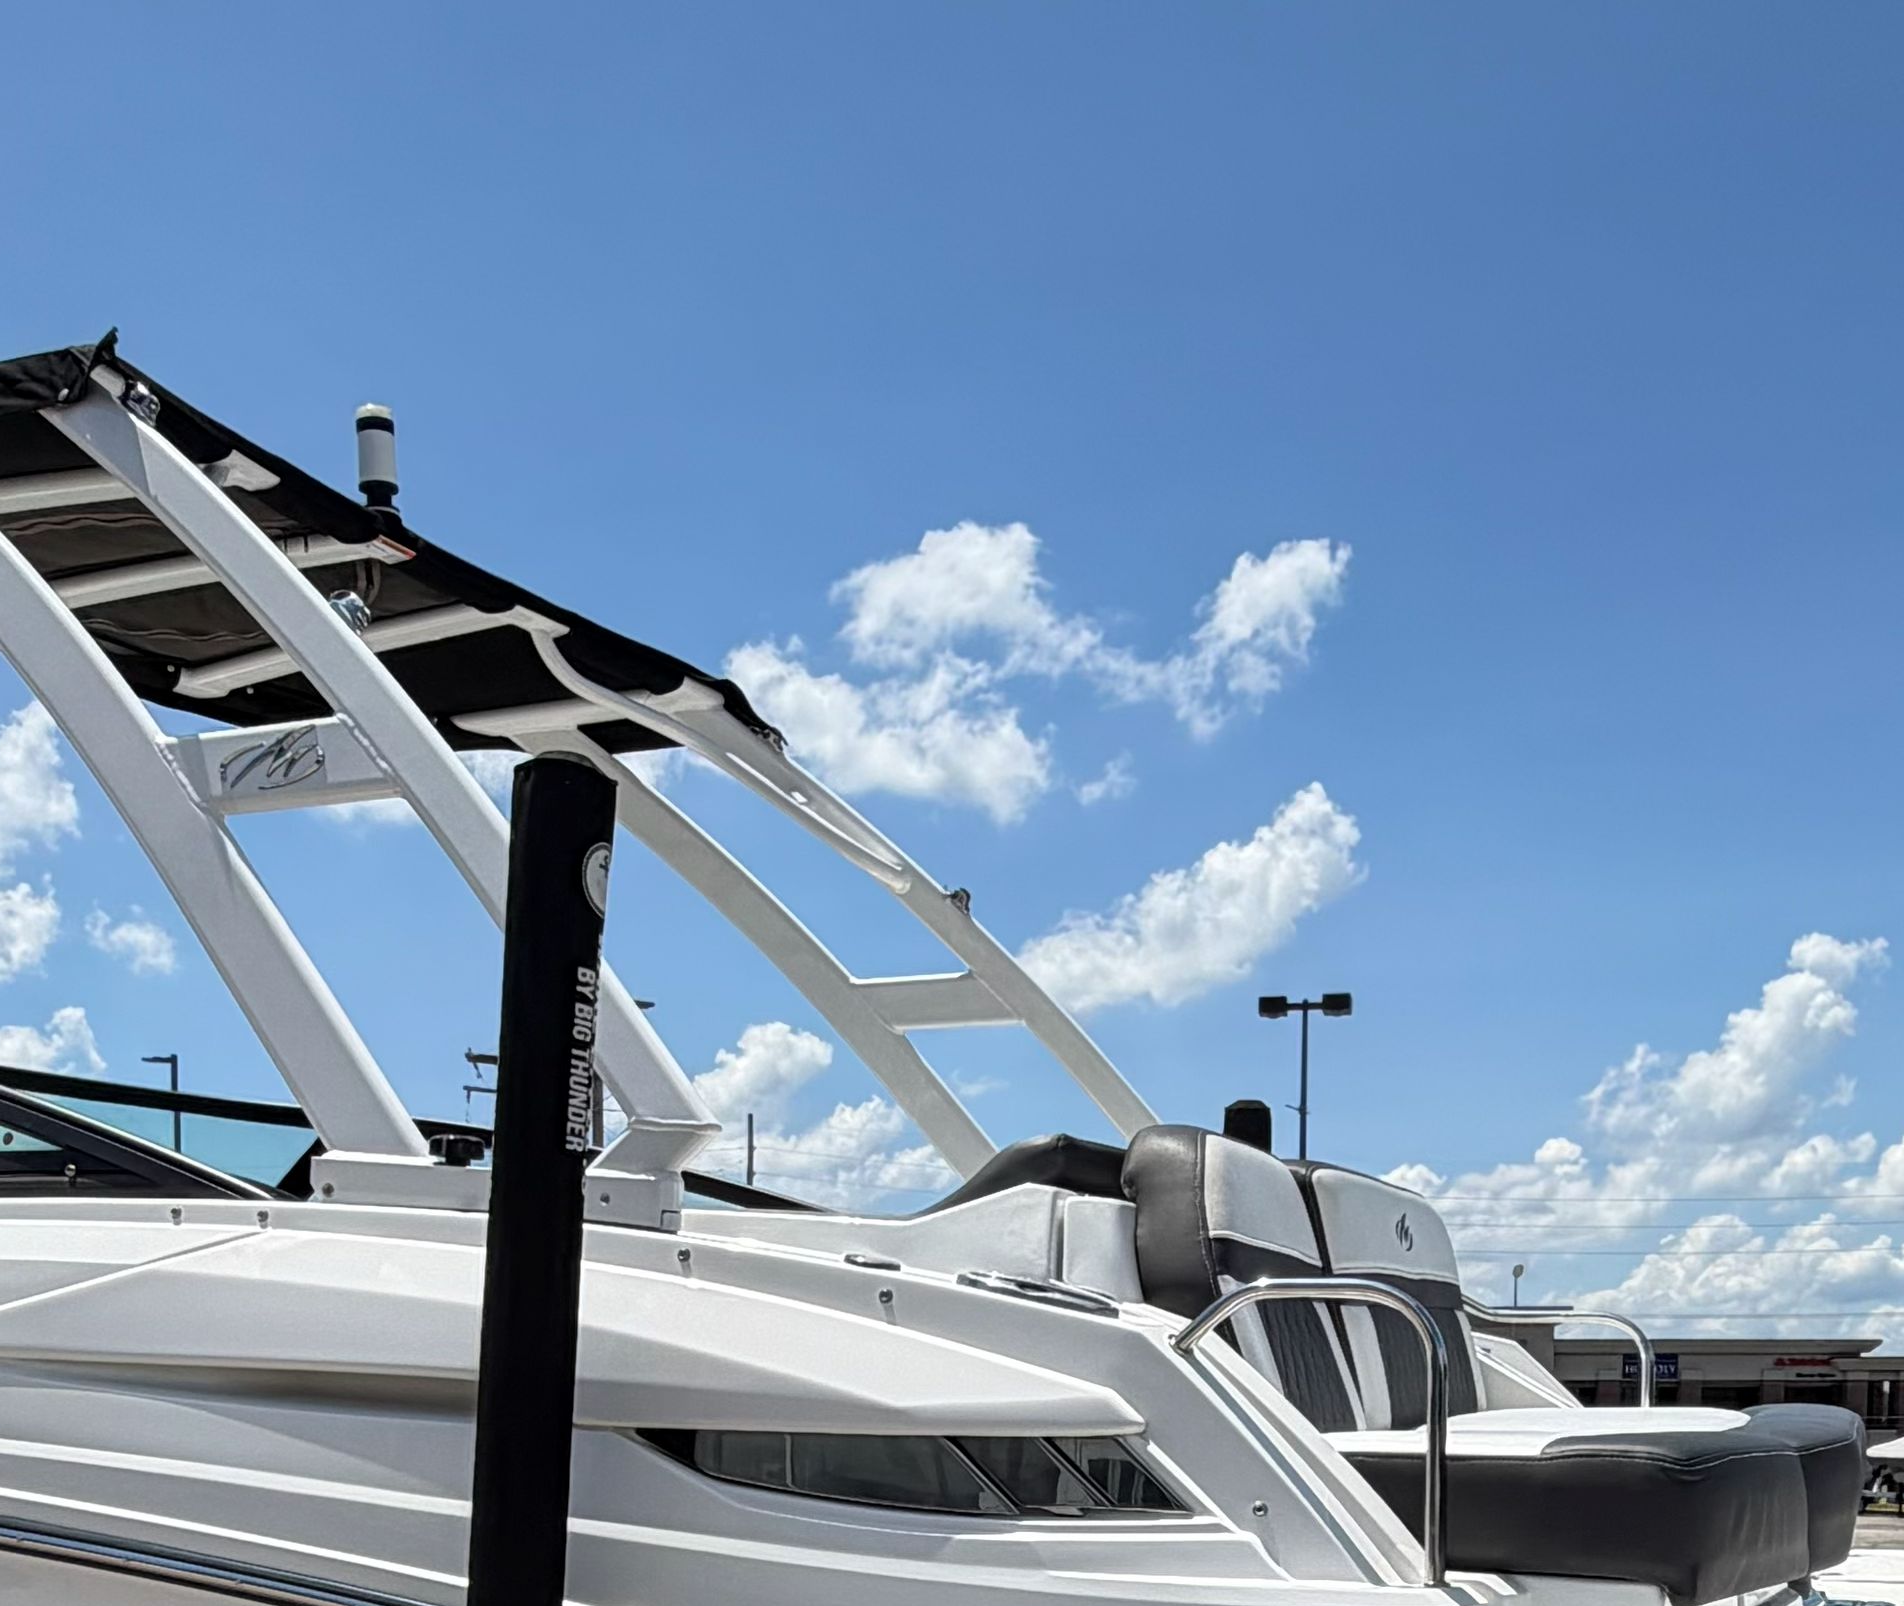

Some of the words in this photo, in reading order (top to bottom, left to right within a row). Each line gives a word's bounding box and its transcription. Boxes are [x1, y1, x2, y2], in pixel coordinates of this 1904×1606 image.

[576, 966, 596, 1000] BY
[572, 1003, 594, 1042] BIG
[565, 1048, 590, 1152] THUNDER
